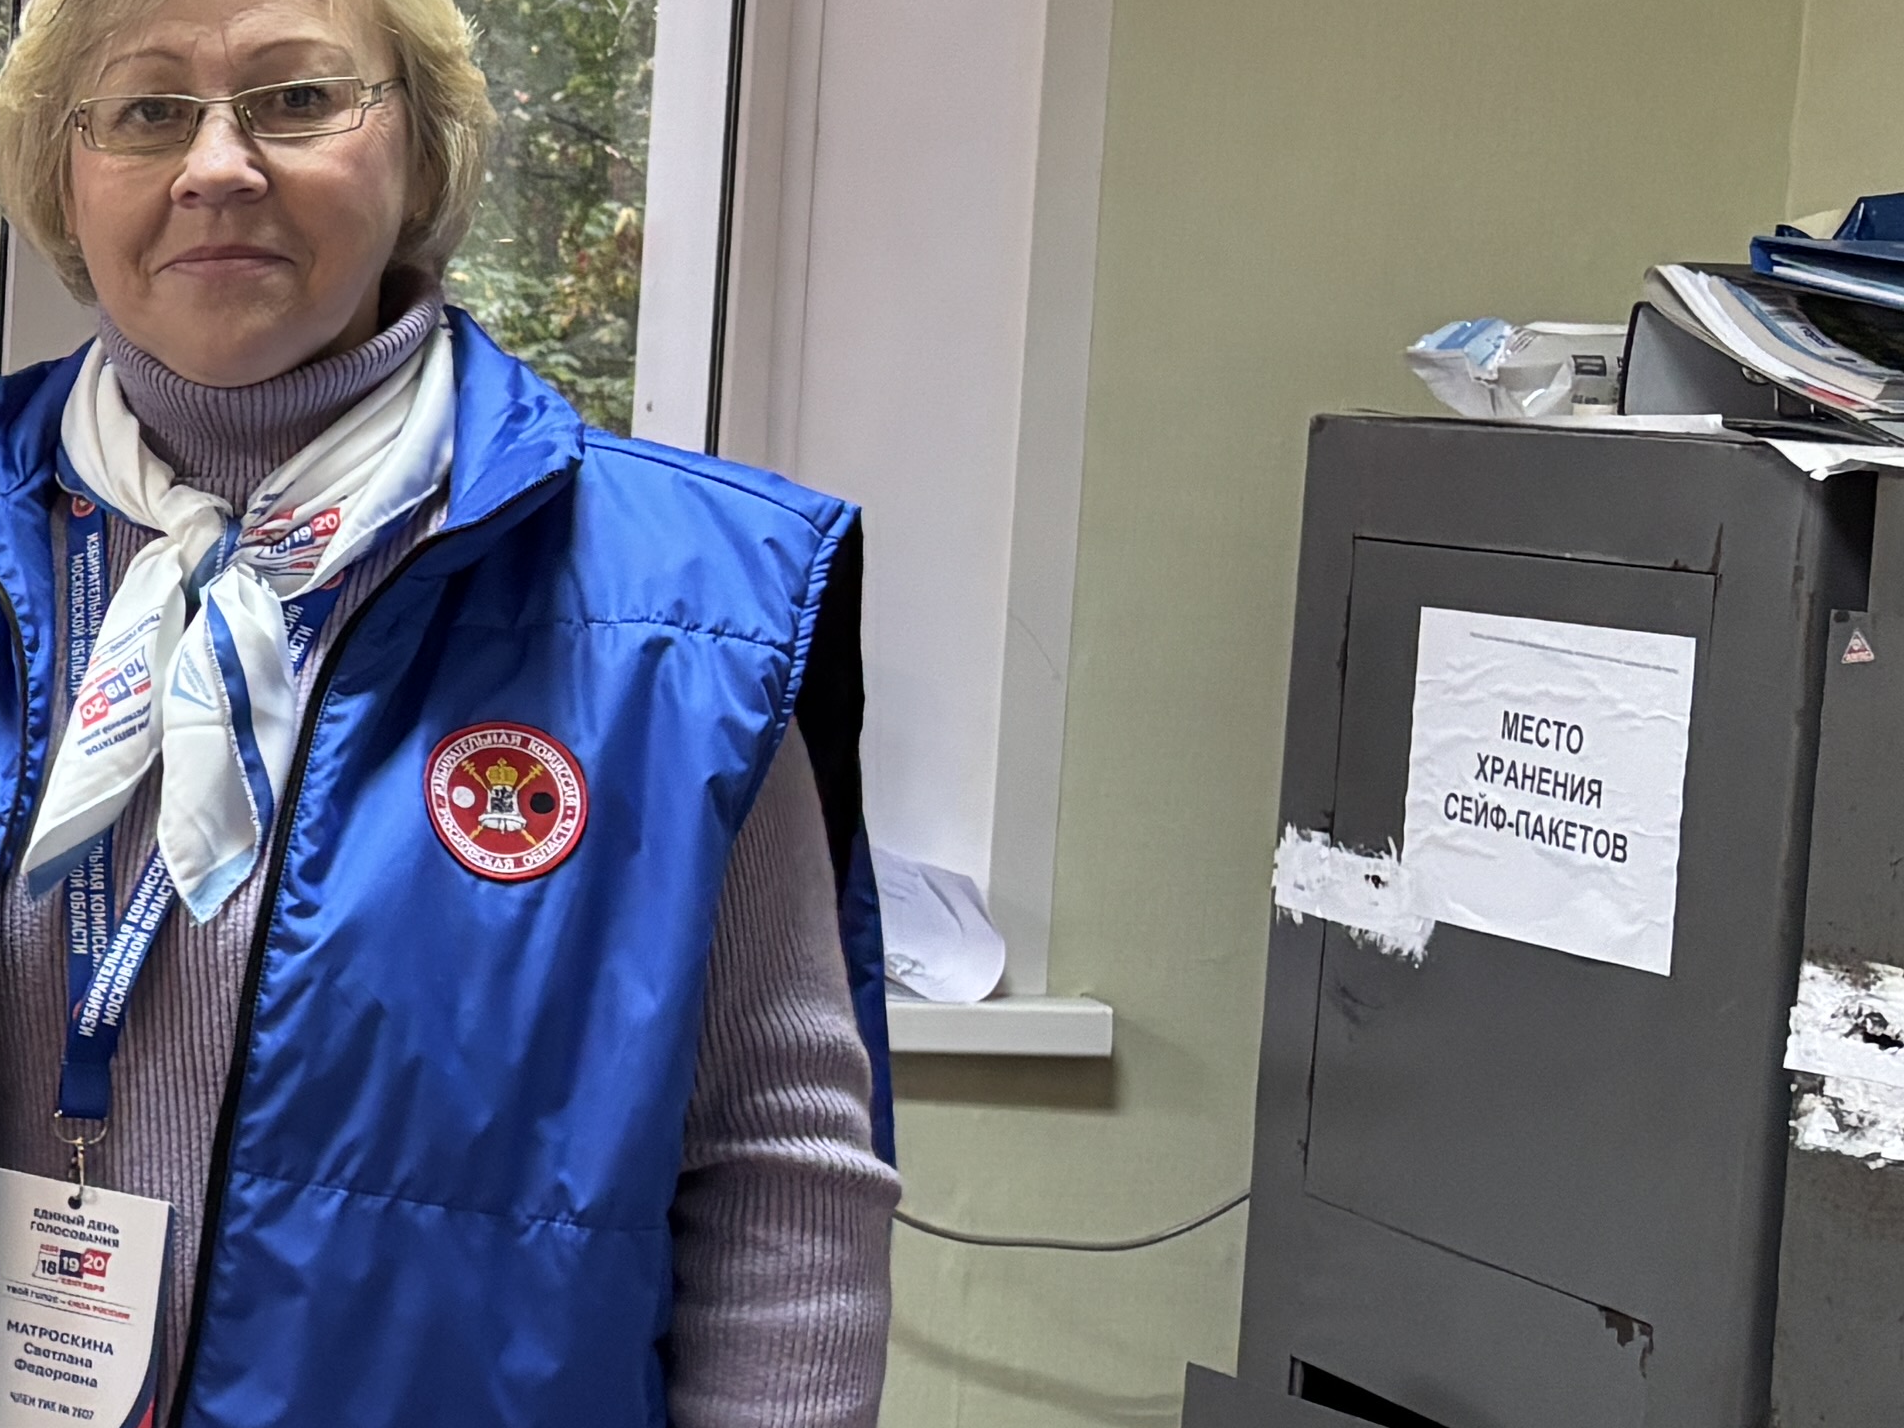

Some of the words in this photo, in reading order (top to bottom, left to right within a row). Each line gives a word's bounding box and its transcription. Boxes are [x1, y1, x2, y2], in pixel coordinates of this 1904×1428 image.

[293, 526, 312, 543] 19
[312, 513, 339, 531] 20
[124, 658, 145, 678] 18
[81, 698, 107, 720] 20
[1500, 710, 1584, 754] МЕСТО
[1474, 753, 1603, 809] ХРАНЕНИЯ
[1443, 791, 1628, 864] СЕЙФ-ПАКЕТОВ
[70, 891, 89, 955] ОБЛАСТИ
[90, 894, 107, 968] КОМИСС
[78, 923, 135, 1037] ИЗБИРАТЕЛЬНАЯ
[102, 930, 151, 1026] МОСКОВСКОЙ
[30, 1221, 120, 1249] ГОЛОСОВАНИЯ
[87, 1219, 120, 1235] ДЕНЬ
[40, 1259, 57, 1275] 18
[62, 1256, 80, 1273] 19
[83, 1254, 106, 1272] 20
[7, 1320, 114, 1356] МАТРОСКИНА
[24, 1342, 93, 1369] Светлана
